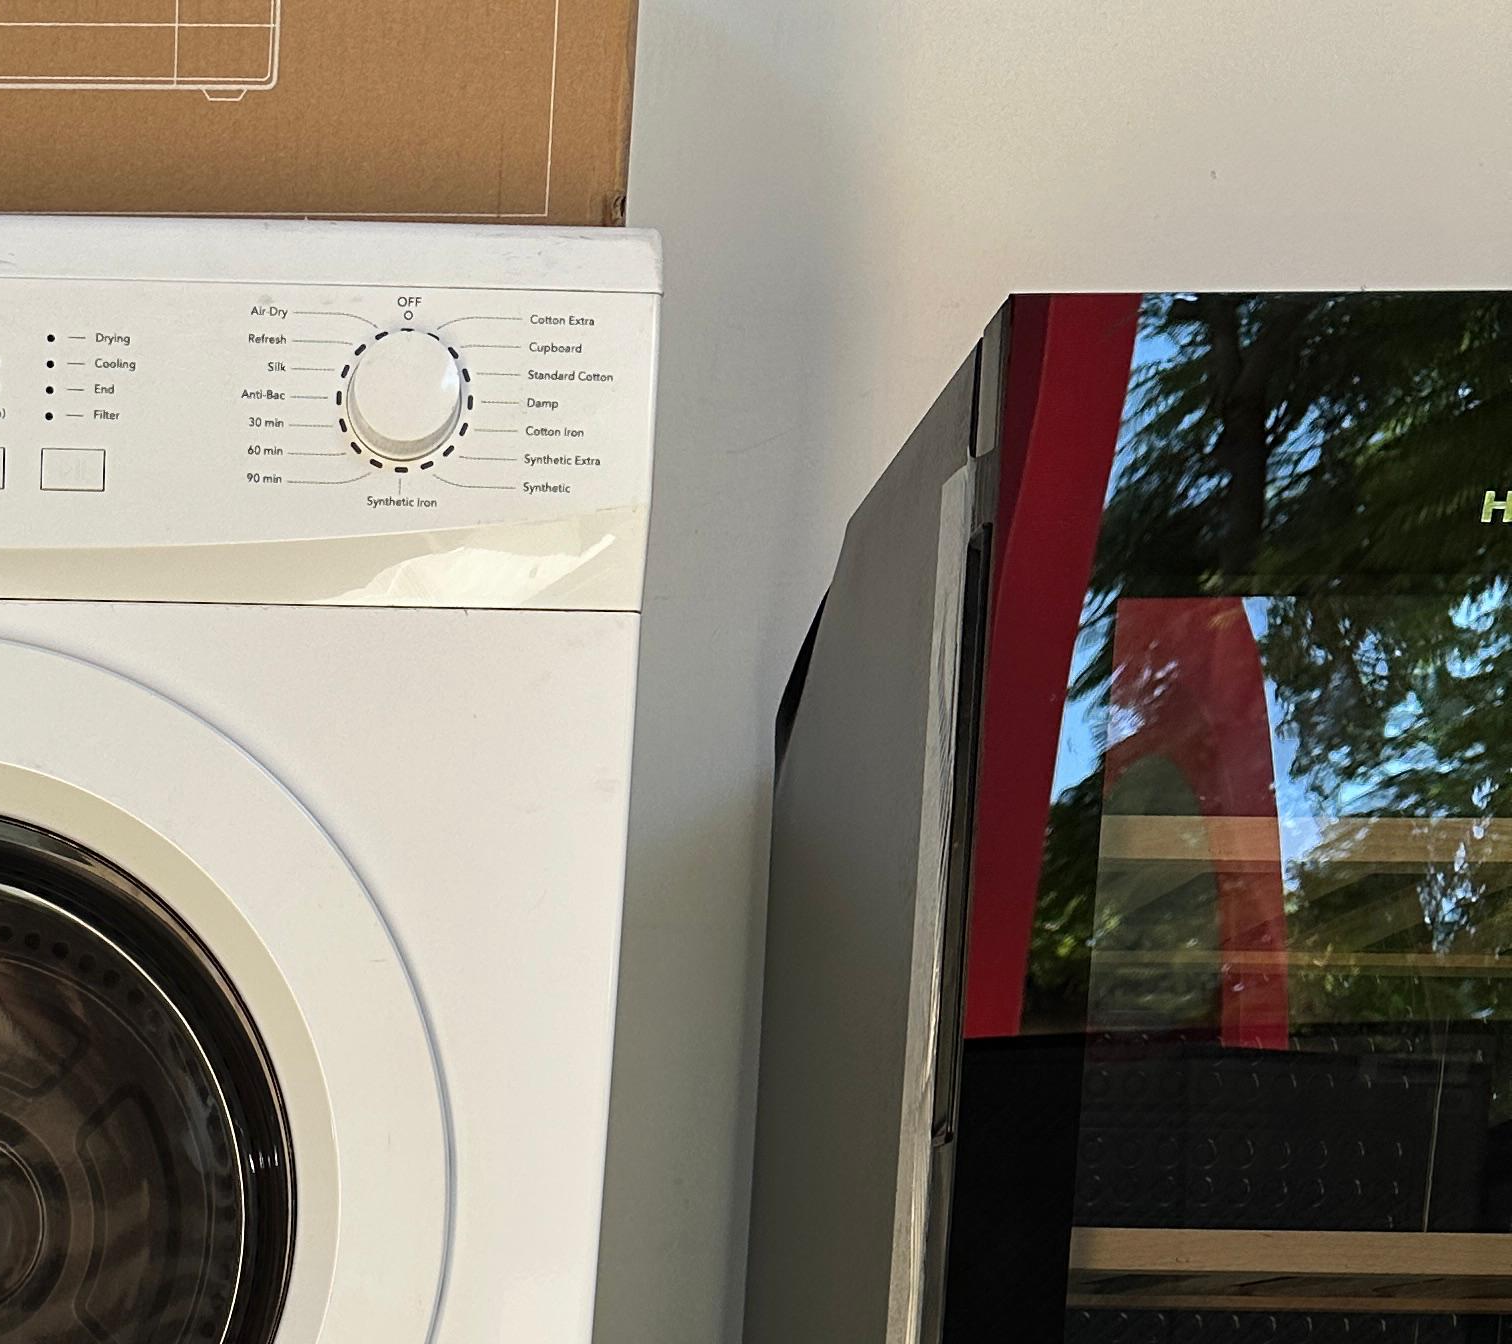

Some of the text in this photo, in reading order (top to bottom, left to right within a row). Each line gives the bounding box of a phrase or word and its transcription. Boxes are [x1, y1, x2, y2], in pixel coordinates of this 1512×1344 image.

[398, 297, 421, 307] OFF
[251, 306, 287, 319] Air-Dry
[530, 315, 594, 325] Cotton Extra
[96, 333, 130, 345] Drying
[249, 334, 286, 344] Refresh
[529, 342, 582, 354] Cupboard
[95, 359, 136, 371] Cooling
[268, 362, 285, 371] Silk
[528, 370, 613, 381] Standard Cotton
[95, 384, 114, 394] End
[241, 390, 285, 400] Anti-Bac
[527, 398, 558, 410] Damp
[94, 410, 119, 420] Filter
[249, 417, 283, 427] 30 min
[526, 426, 584, 437] Cotton Iron
[248, 446, 283, 455] 60 min
[524, 454, 600, 466] Synthetic Extra
[247, 473, 281, 483] 90 min
[523, 482, 570, 495] Synthetic
[367, 496, 437, 508] Synthetic Iron
